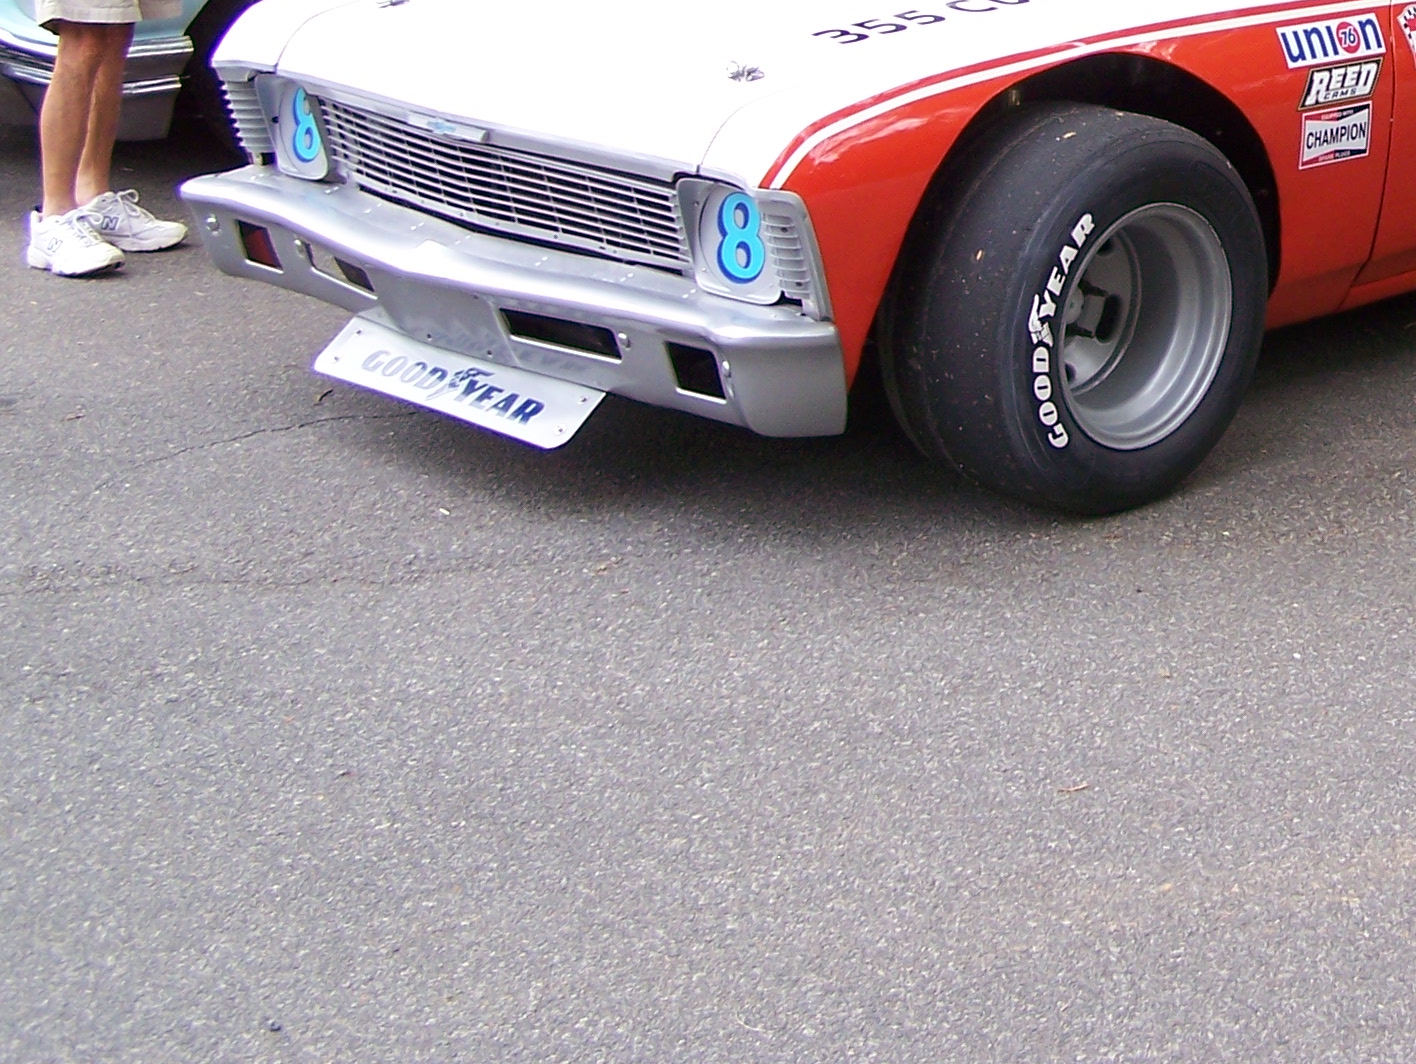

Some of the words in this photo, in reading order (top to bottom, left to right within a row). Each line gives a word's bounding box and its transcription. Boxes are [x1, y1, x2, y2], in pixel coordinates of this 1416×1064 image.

[811, 10, 946, 44] 355
[1340, 27, 1356, 46] 76
[1304, 62, 1378, 106] REED
[1323, 87, 1357, 100] CAMS
[1306, 121, 1367, 149] CHAMPION
[717, 192, 766, 284] 8
[1028, 212, 1096, 449] GOODYEAR
[361, 349, 546, 425] GOODYEAR
